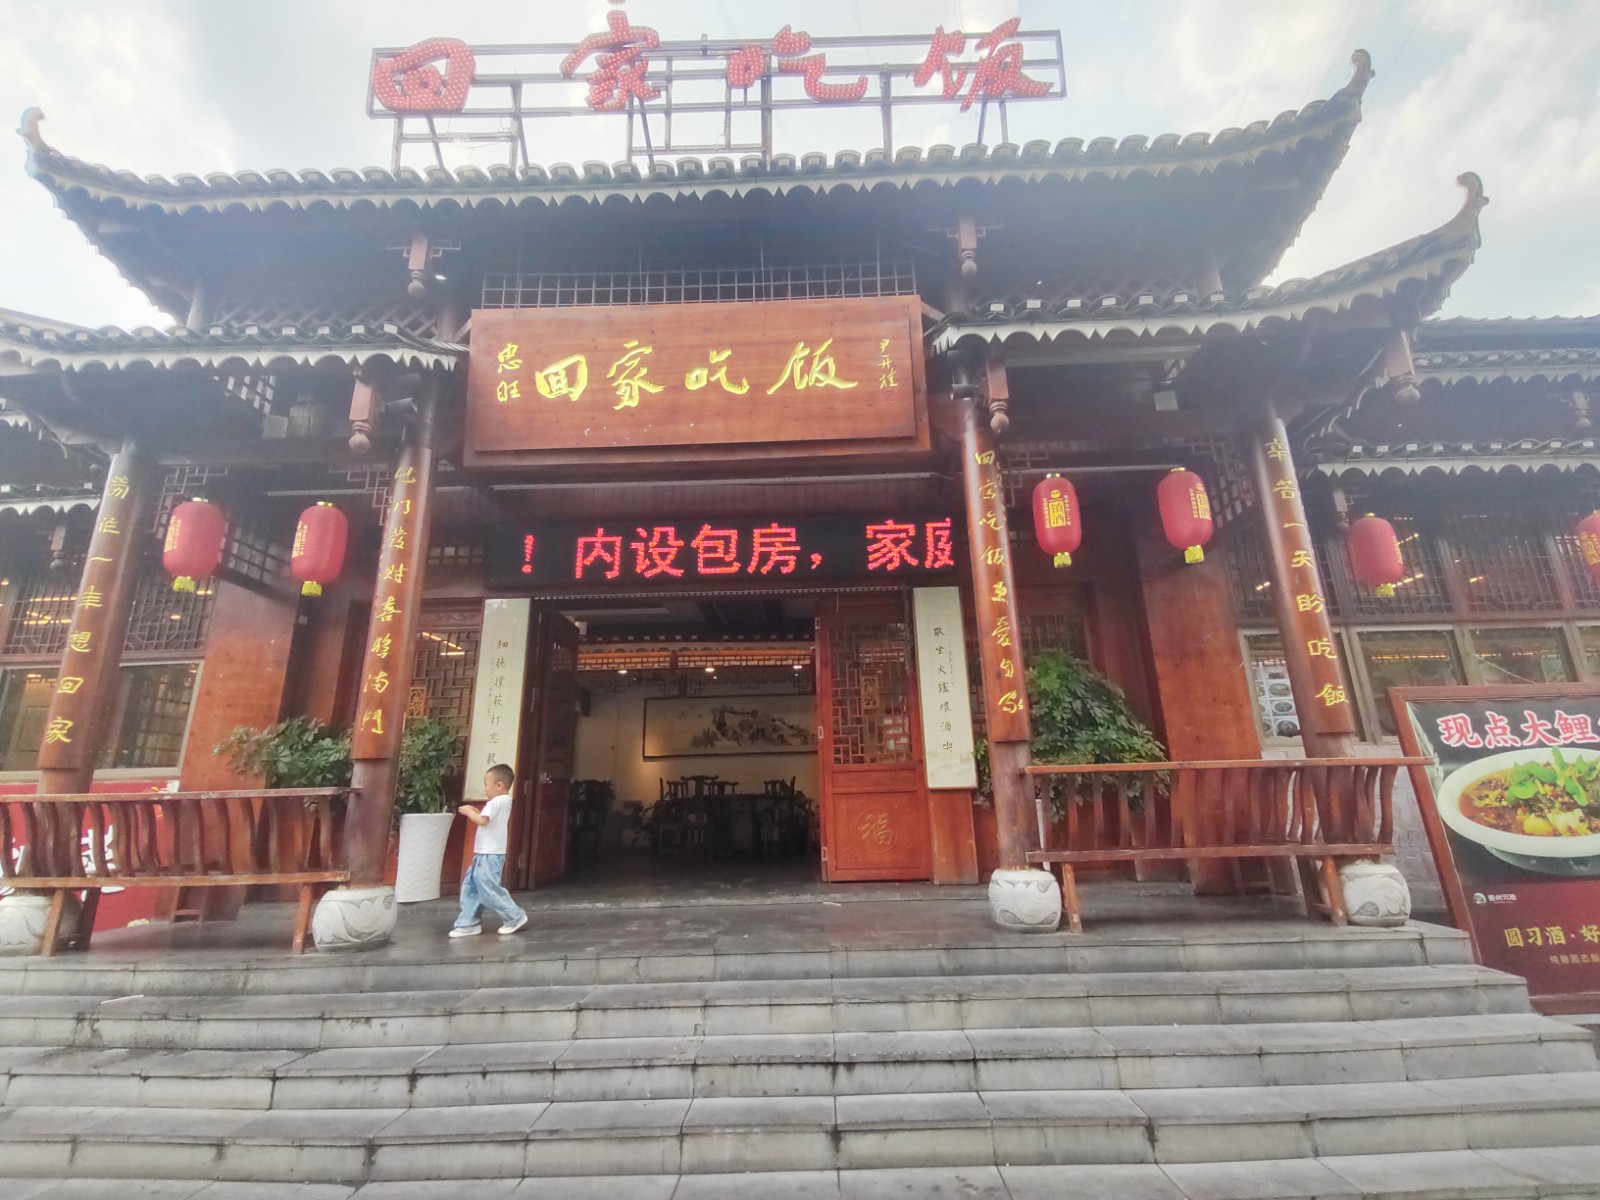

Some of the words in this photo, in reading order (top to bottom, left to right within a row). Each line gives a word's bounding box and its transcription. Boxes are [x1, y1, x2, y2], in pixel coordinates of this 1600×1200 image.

[534, 338, 859, 410] 回家吃饭
[1437, 710, 1600, 748] 现点大鲤
